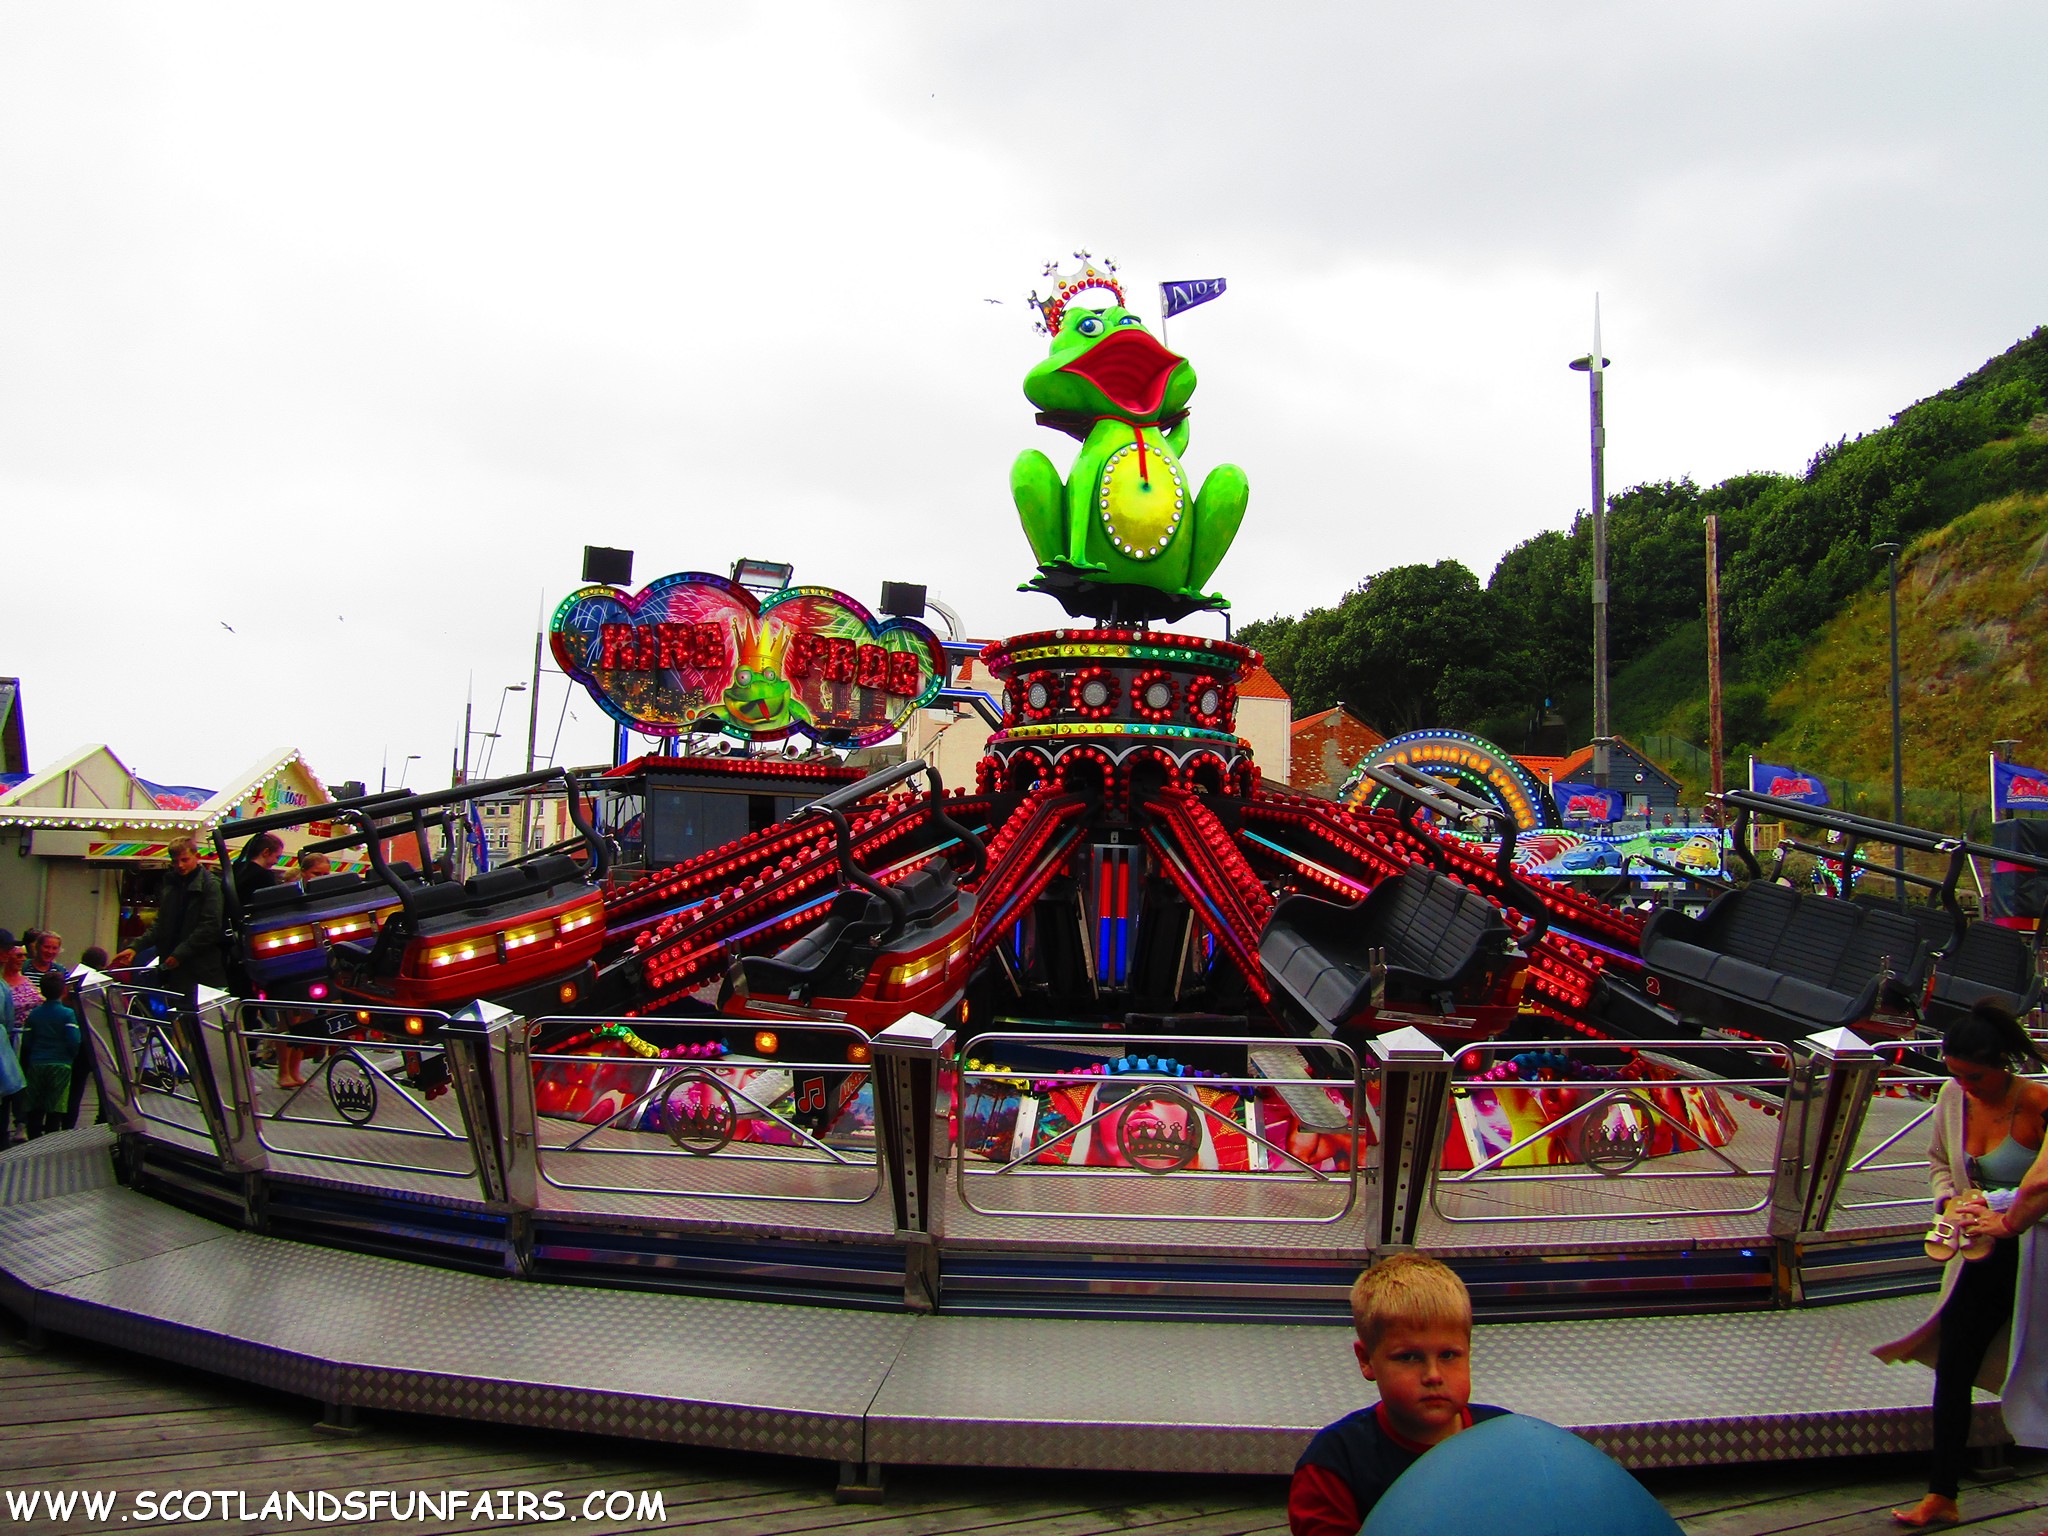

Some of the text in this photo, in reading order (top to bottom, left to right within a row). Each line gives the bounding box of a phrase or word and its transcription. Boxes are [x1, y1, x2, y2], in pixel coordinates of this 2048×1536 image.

[600, 621, 919, 698] KING FROG
[1410, 744, 1493, 775] RADIATOR
[1487, 767, 1536, 830] SPRINGS
[1645, 976, 1661, 996] 2
